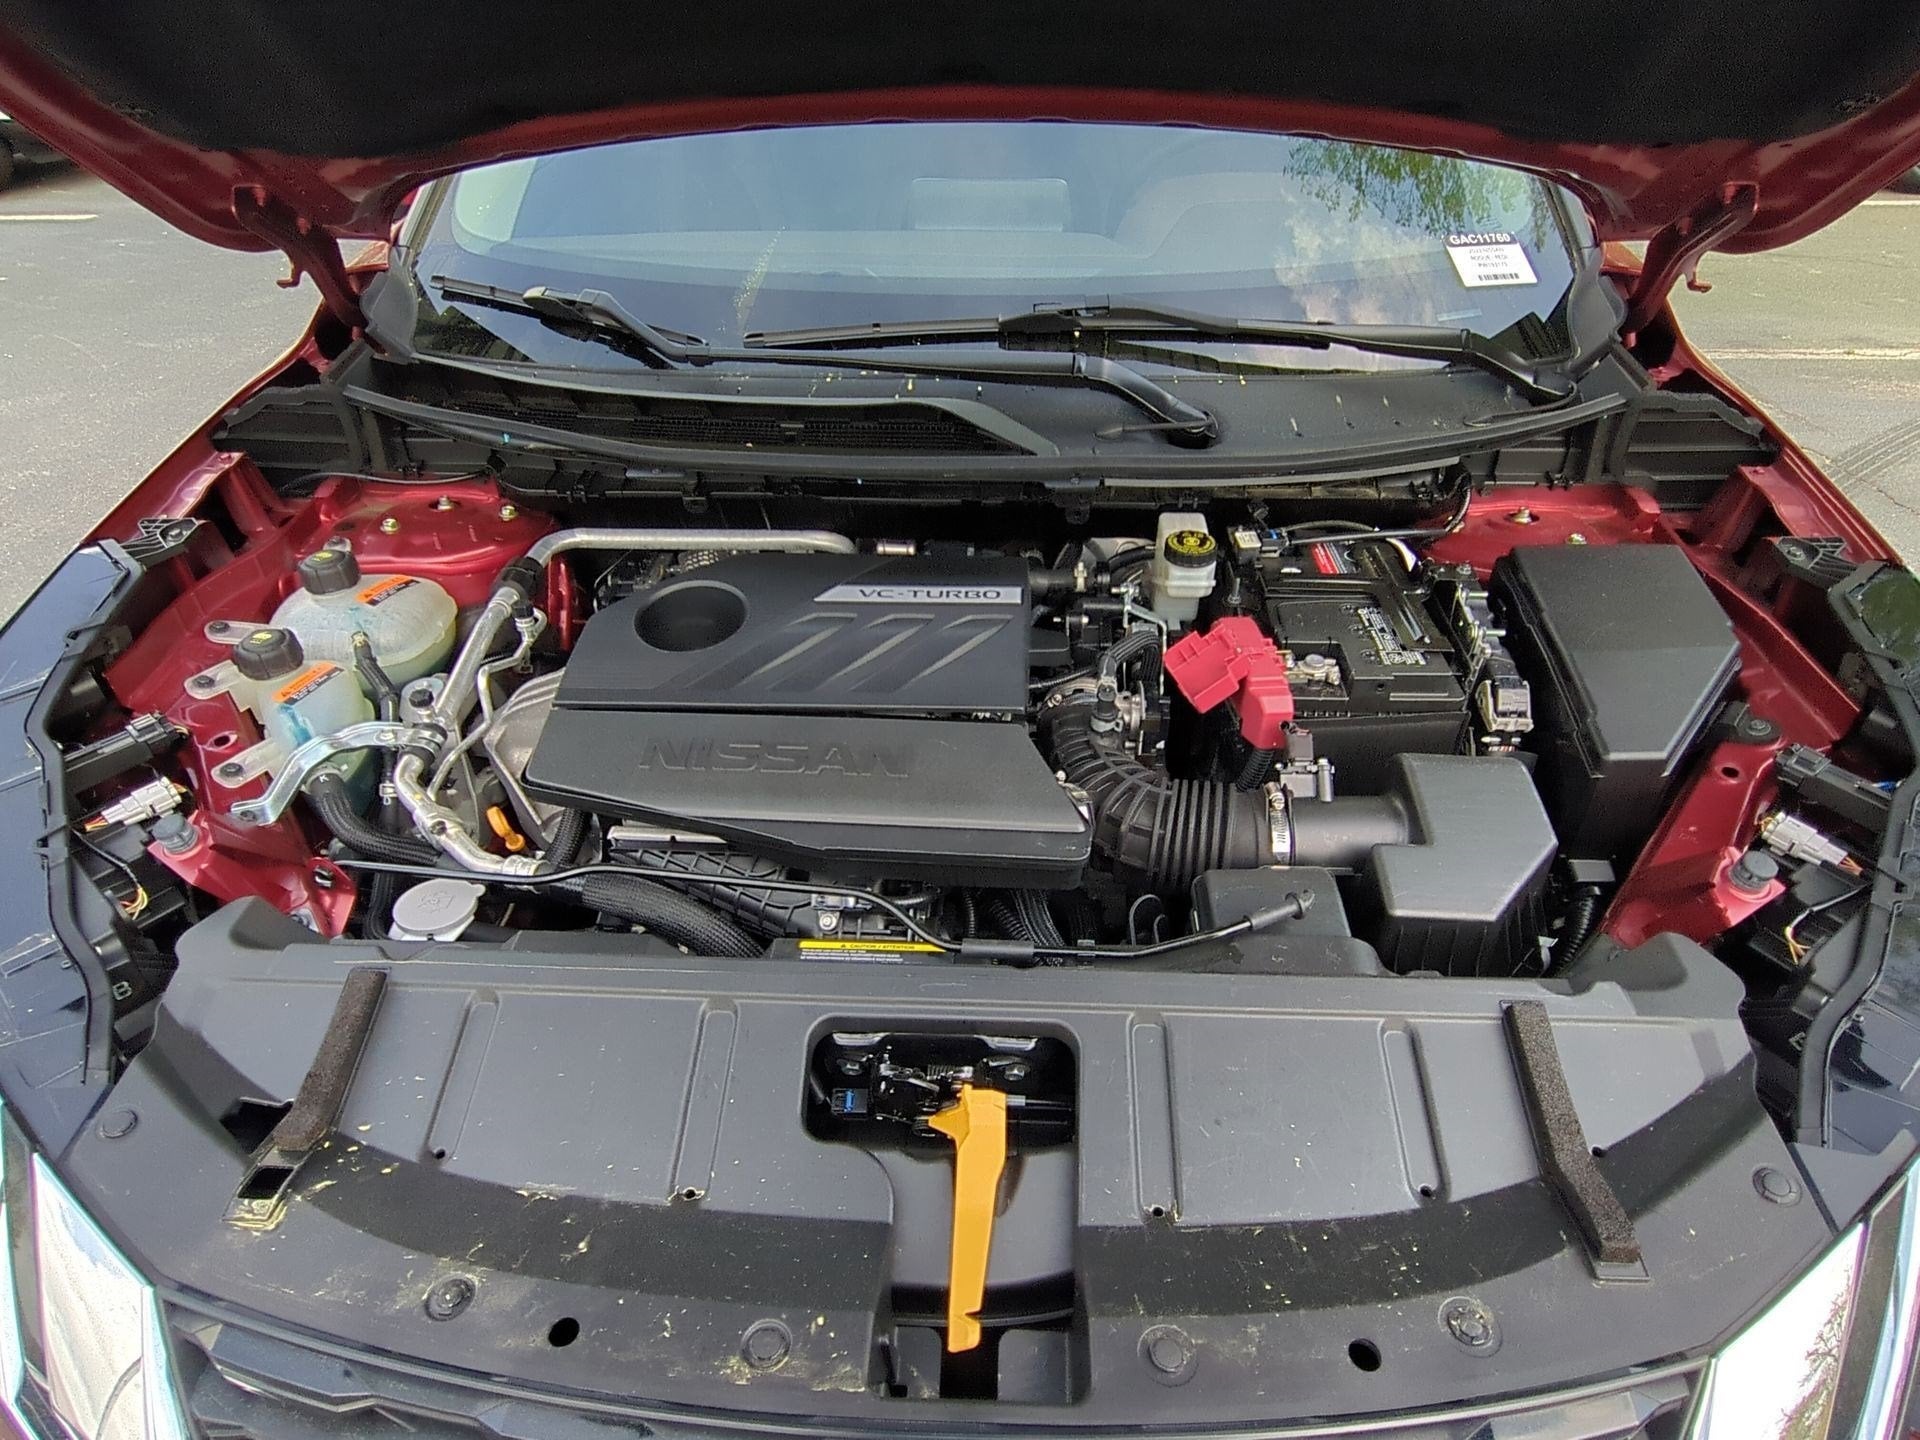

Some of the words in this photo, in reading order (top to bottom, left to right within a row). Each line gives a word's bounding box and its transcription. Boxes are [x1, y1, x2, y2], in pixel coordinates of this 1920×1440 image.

[1449, 233, 1511, 245] GAC11760
[858, 588, 1001, 600] VC-TURBO
[638, 736, 911, 778] NISSAN
